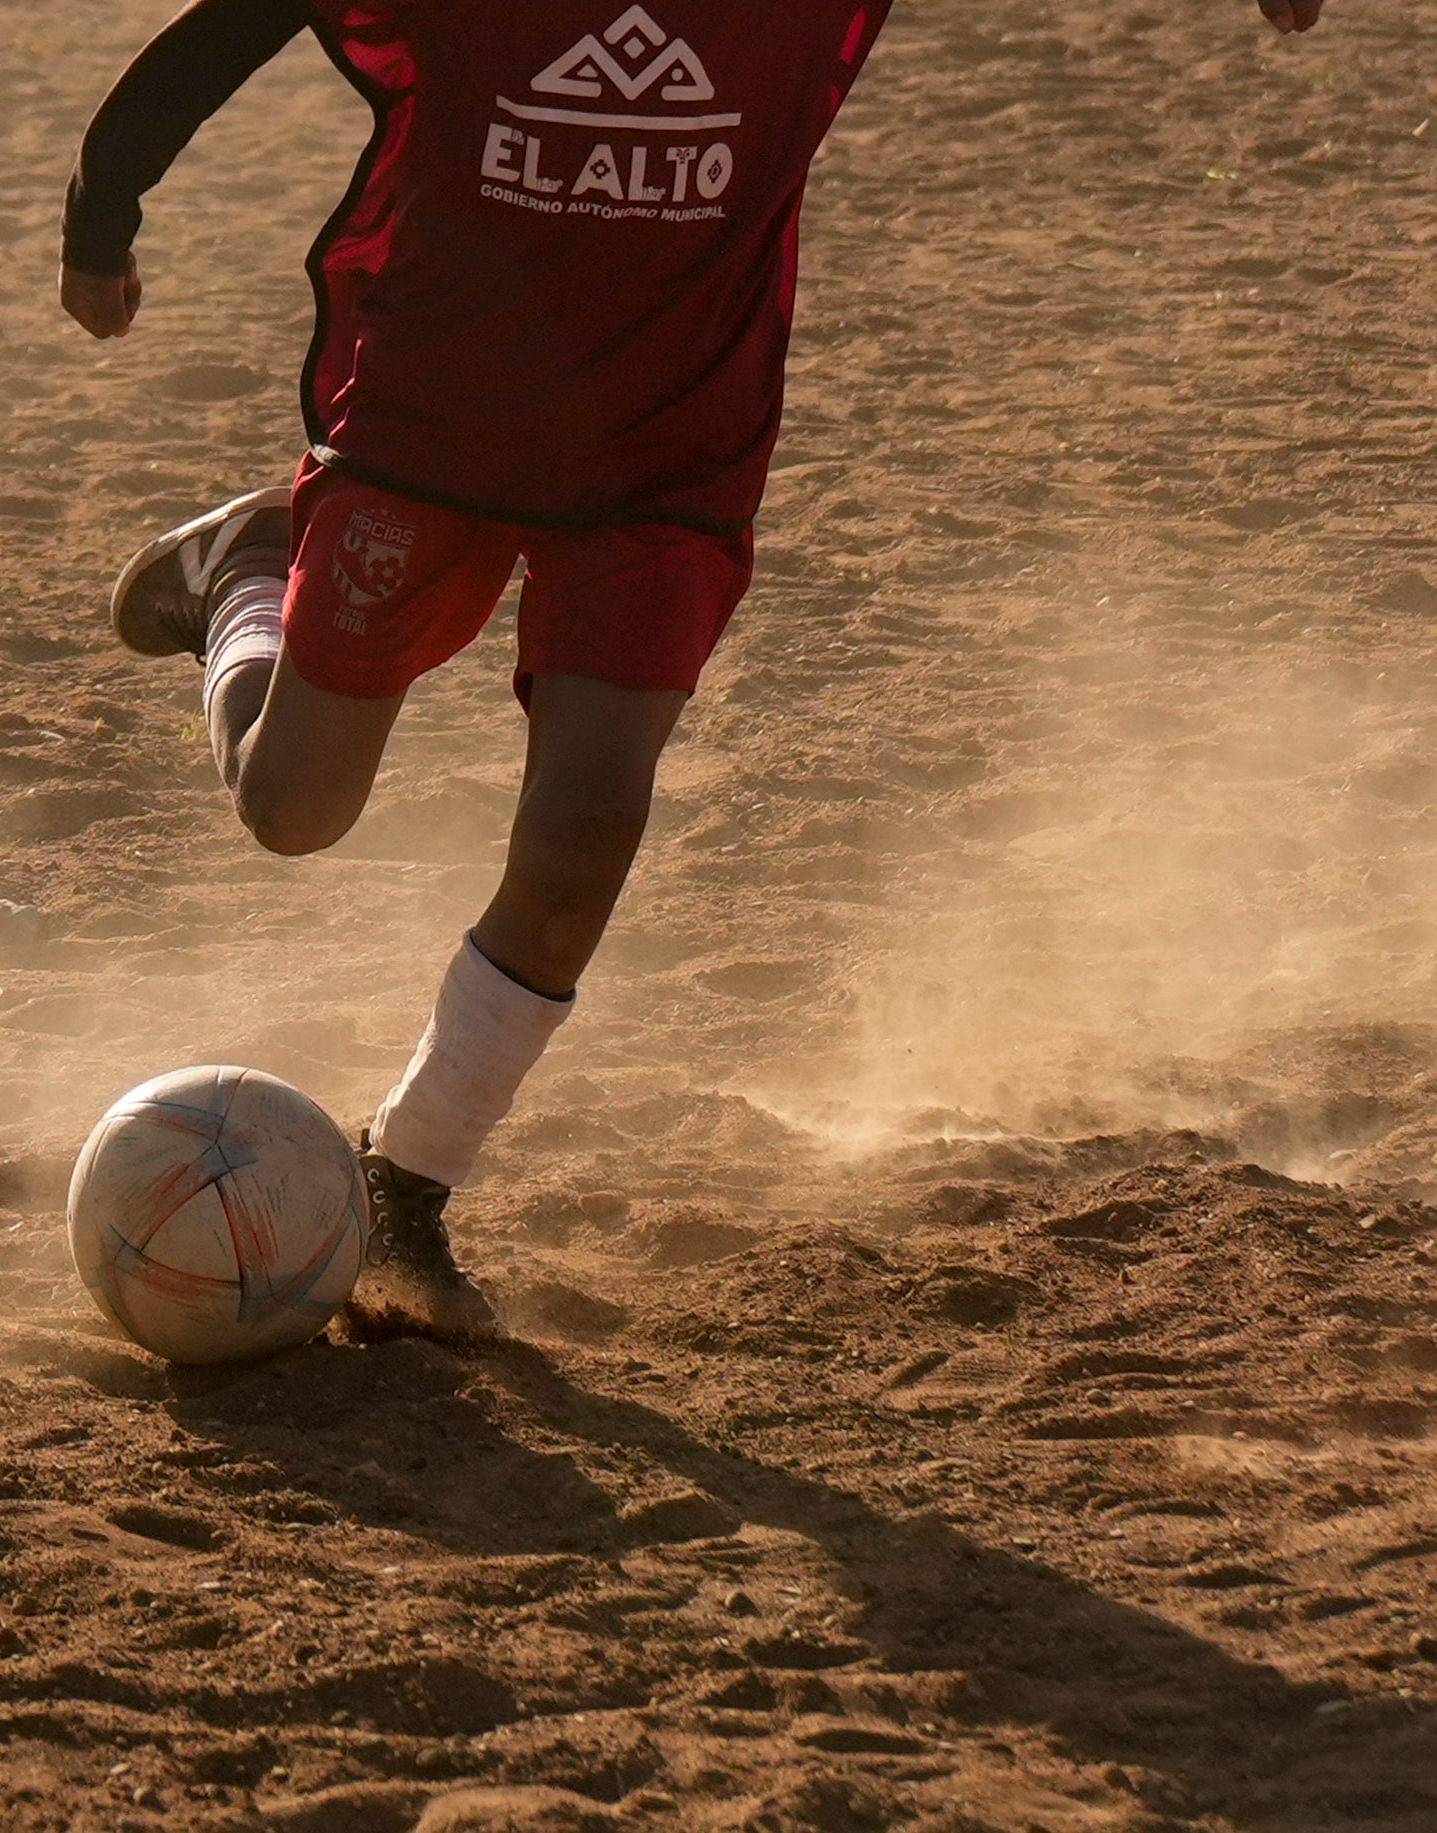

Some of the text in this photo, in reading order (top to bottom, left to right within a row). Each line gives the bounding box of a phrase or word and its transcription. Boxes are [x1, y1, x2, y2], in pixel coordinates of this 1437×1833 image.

[480, 122, 734, 203] EL ALTO
[480, 183, 726, 223] GOBIERNO AUTÓNOMO MUNICIPAL
[348, 511, 415, 545] MACIAS
[333, 610, 367, 637] TOTAL
